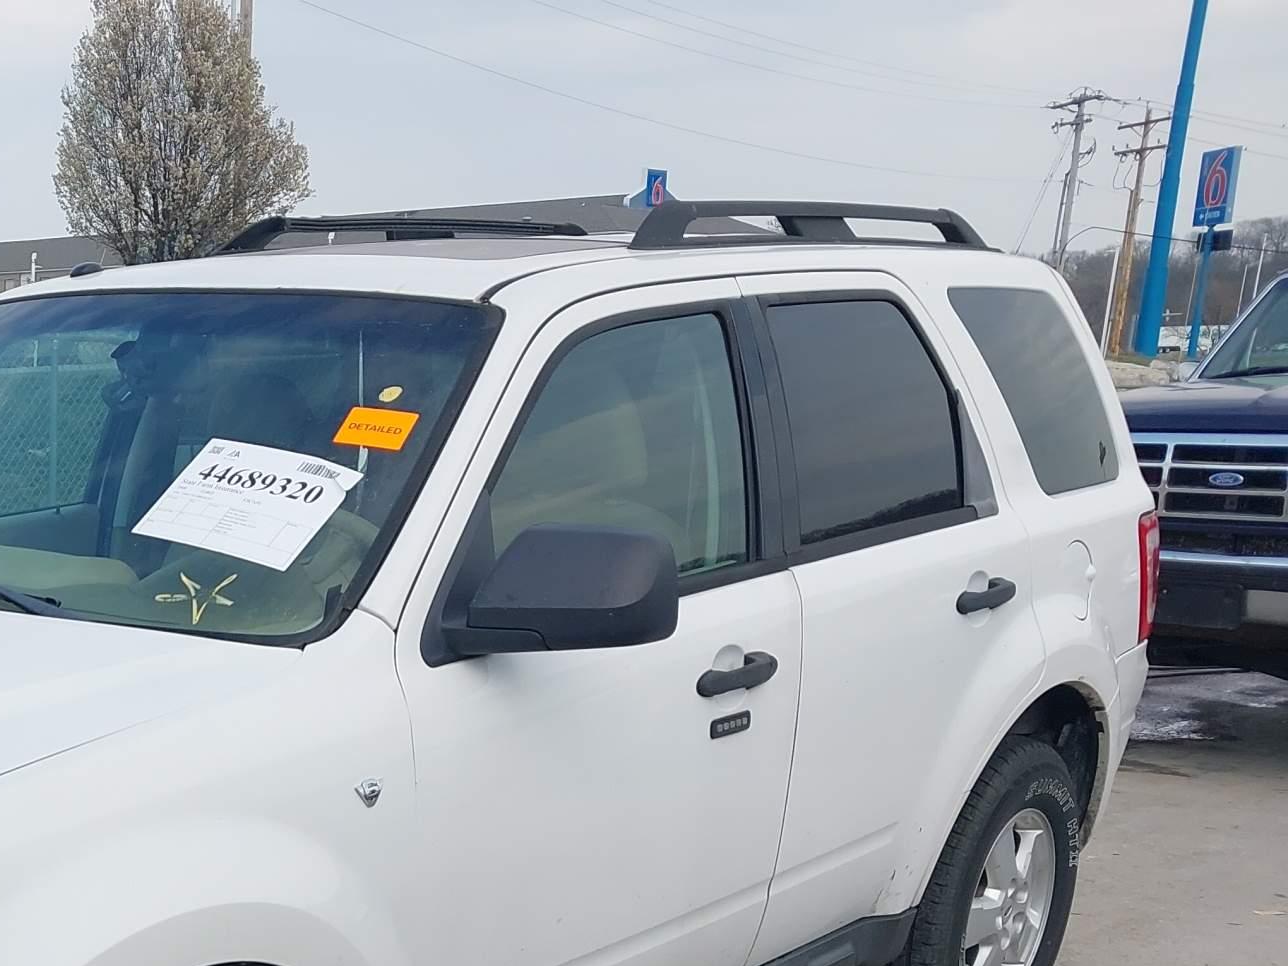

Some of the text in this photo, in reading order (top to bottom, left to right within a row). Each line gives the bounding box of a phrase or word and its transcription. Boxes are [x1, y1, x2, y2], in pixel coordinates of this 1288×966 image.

[652, 176, 664, 208] 6
[1203, 150, 1228, 208] 6
[348, 422, 402, 435] DETAILED
[199, 463, 324, 504] 44689320
